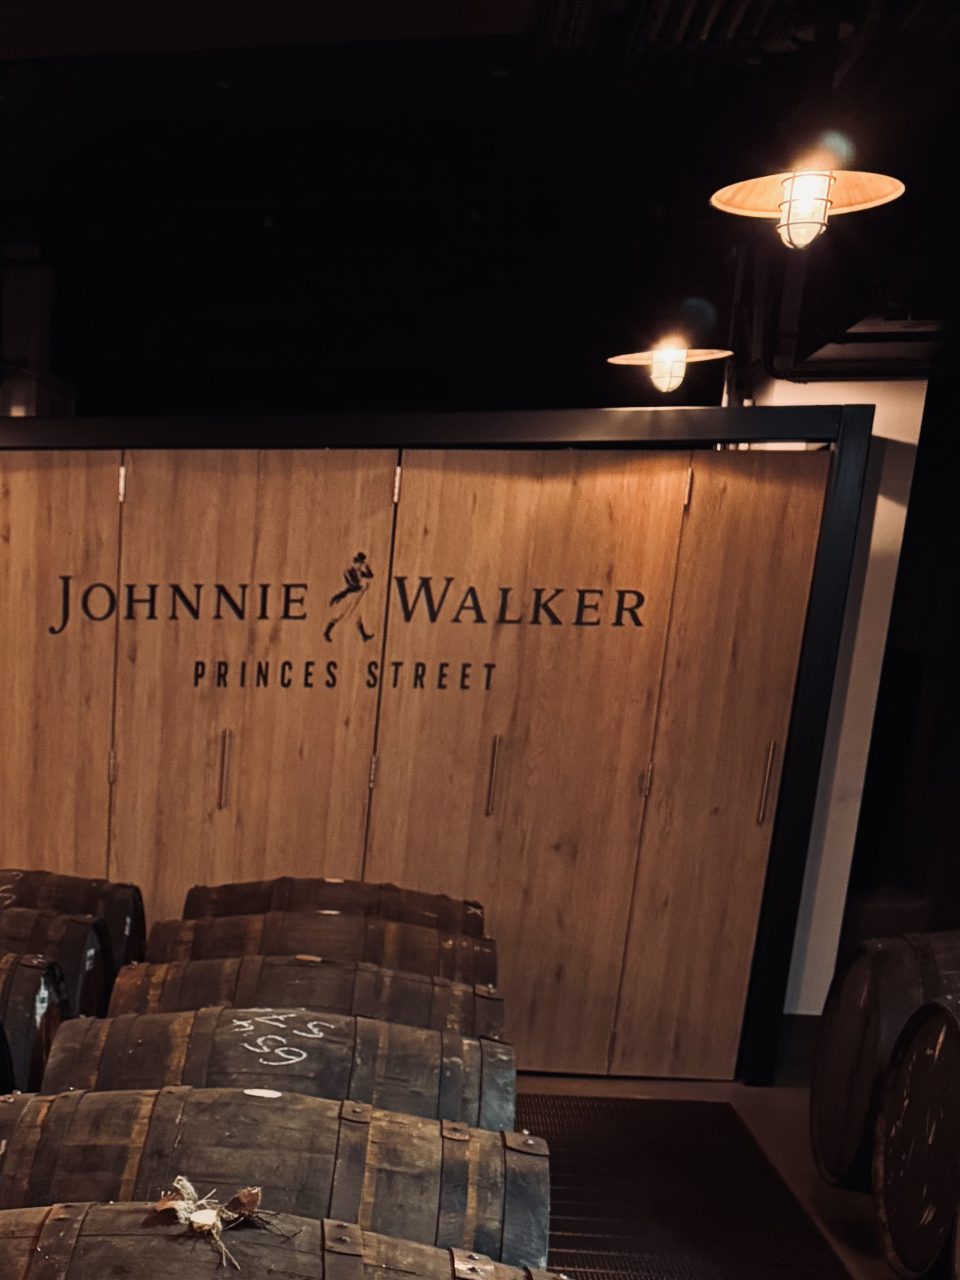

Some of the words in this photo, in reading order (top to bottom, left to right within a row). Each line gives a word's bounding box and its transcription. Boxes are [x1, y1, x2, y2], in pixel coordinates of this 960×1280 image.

[49, 575, 309, 635] JOHNNIE
[393, 575, 645, 628] WALKER
[194, 660, 338, 690] PRINCES
[366, 661, 497, 692] STREET
